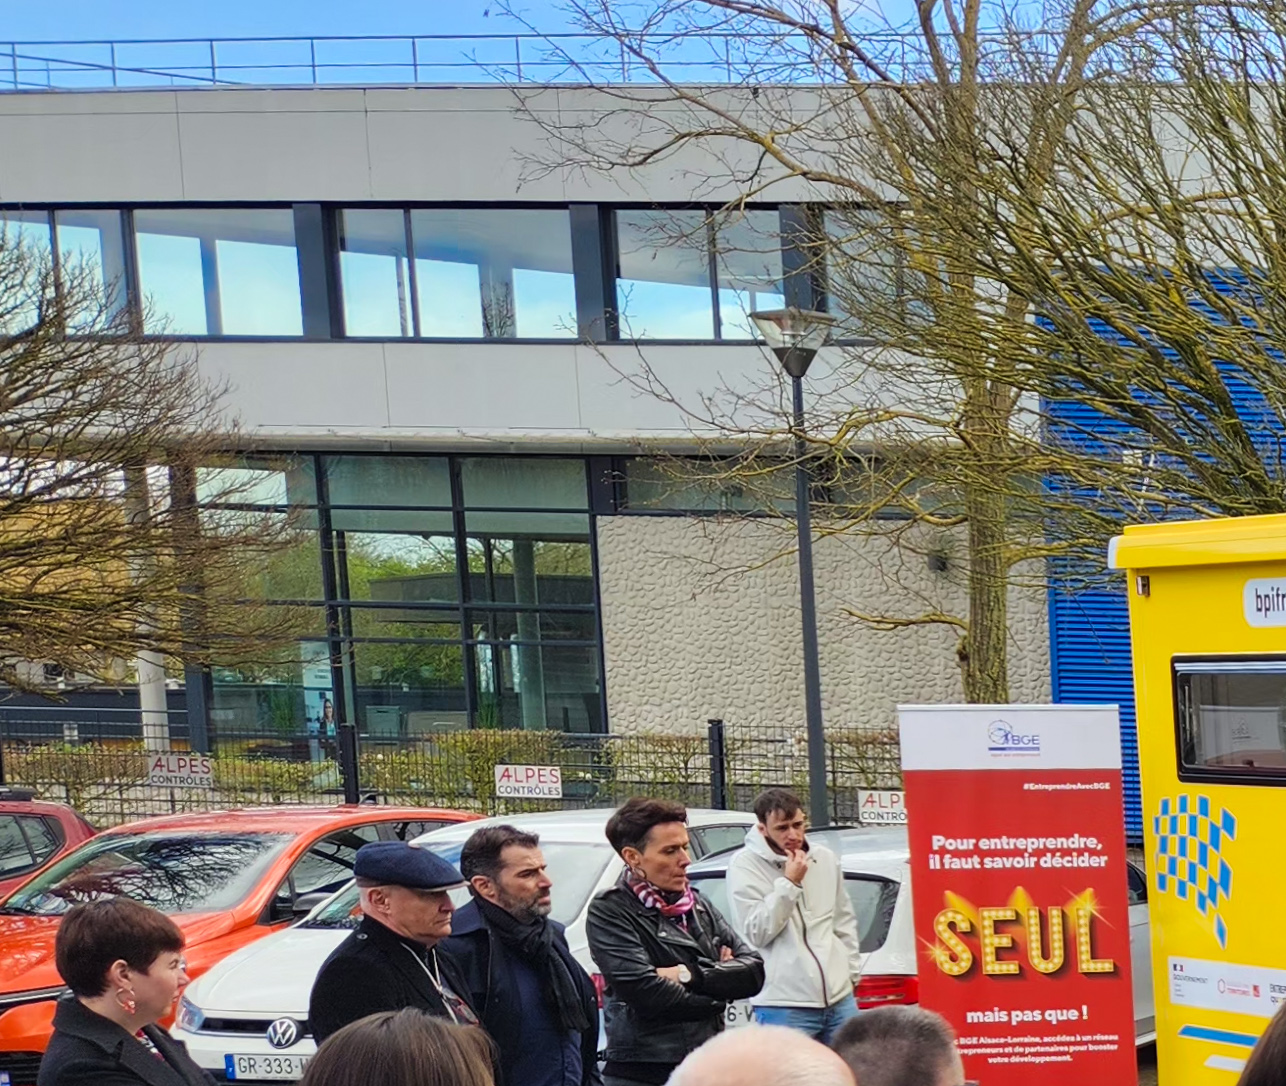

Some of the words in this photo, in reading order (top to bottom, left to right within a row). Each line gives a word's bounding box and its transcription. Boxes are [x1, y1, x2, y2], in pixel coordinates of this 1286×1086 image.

[1011, 735, 1040, 745] BGE
[152, 757, 211, 774] ALPES
[151, 774, 212, 786] CONTRÔLES
[498, 767, 560, 784] ALPES
[497, 784, 560, 796] CONTRÔLES
[862, 793, 906, 808] ALP
[861, 810, 907, 821] CONTRÔ
[931, 835, 976, 850] Pour
[978, 834, 1103, 853] entreprendre,
[929, 854, 941, 869] il
[943, 854, 982, 869] faut
[983, 853, 1038, 868] savoir
[1039, 852, 1108, 868] décider
[933, 906, 1115, 976] SEUL
[966, 1007, 1009, 1023] mais
[1011, 1009, 1042, 1026] pas
[1044, 1008, 1079, 1024] que
[1081, 1004, 1088, 1020] !
[959, 1036, 978, 1045] BGE
[978, 1035, 1042, 1045] Alsace-Lorraine,
[957, 1047, 1003, 1055] trepreneurs
[1013, 1045, 1024, 1053] de
[1069, 1045, 1088, 1053] pour
[987, 1056, 1009, 1064] votre
